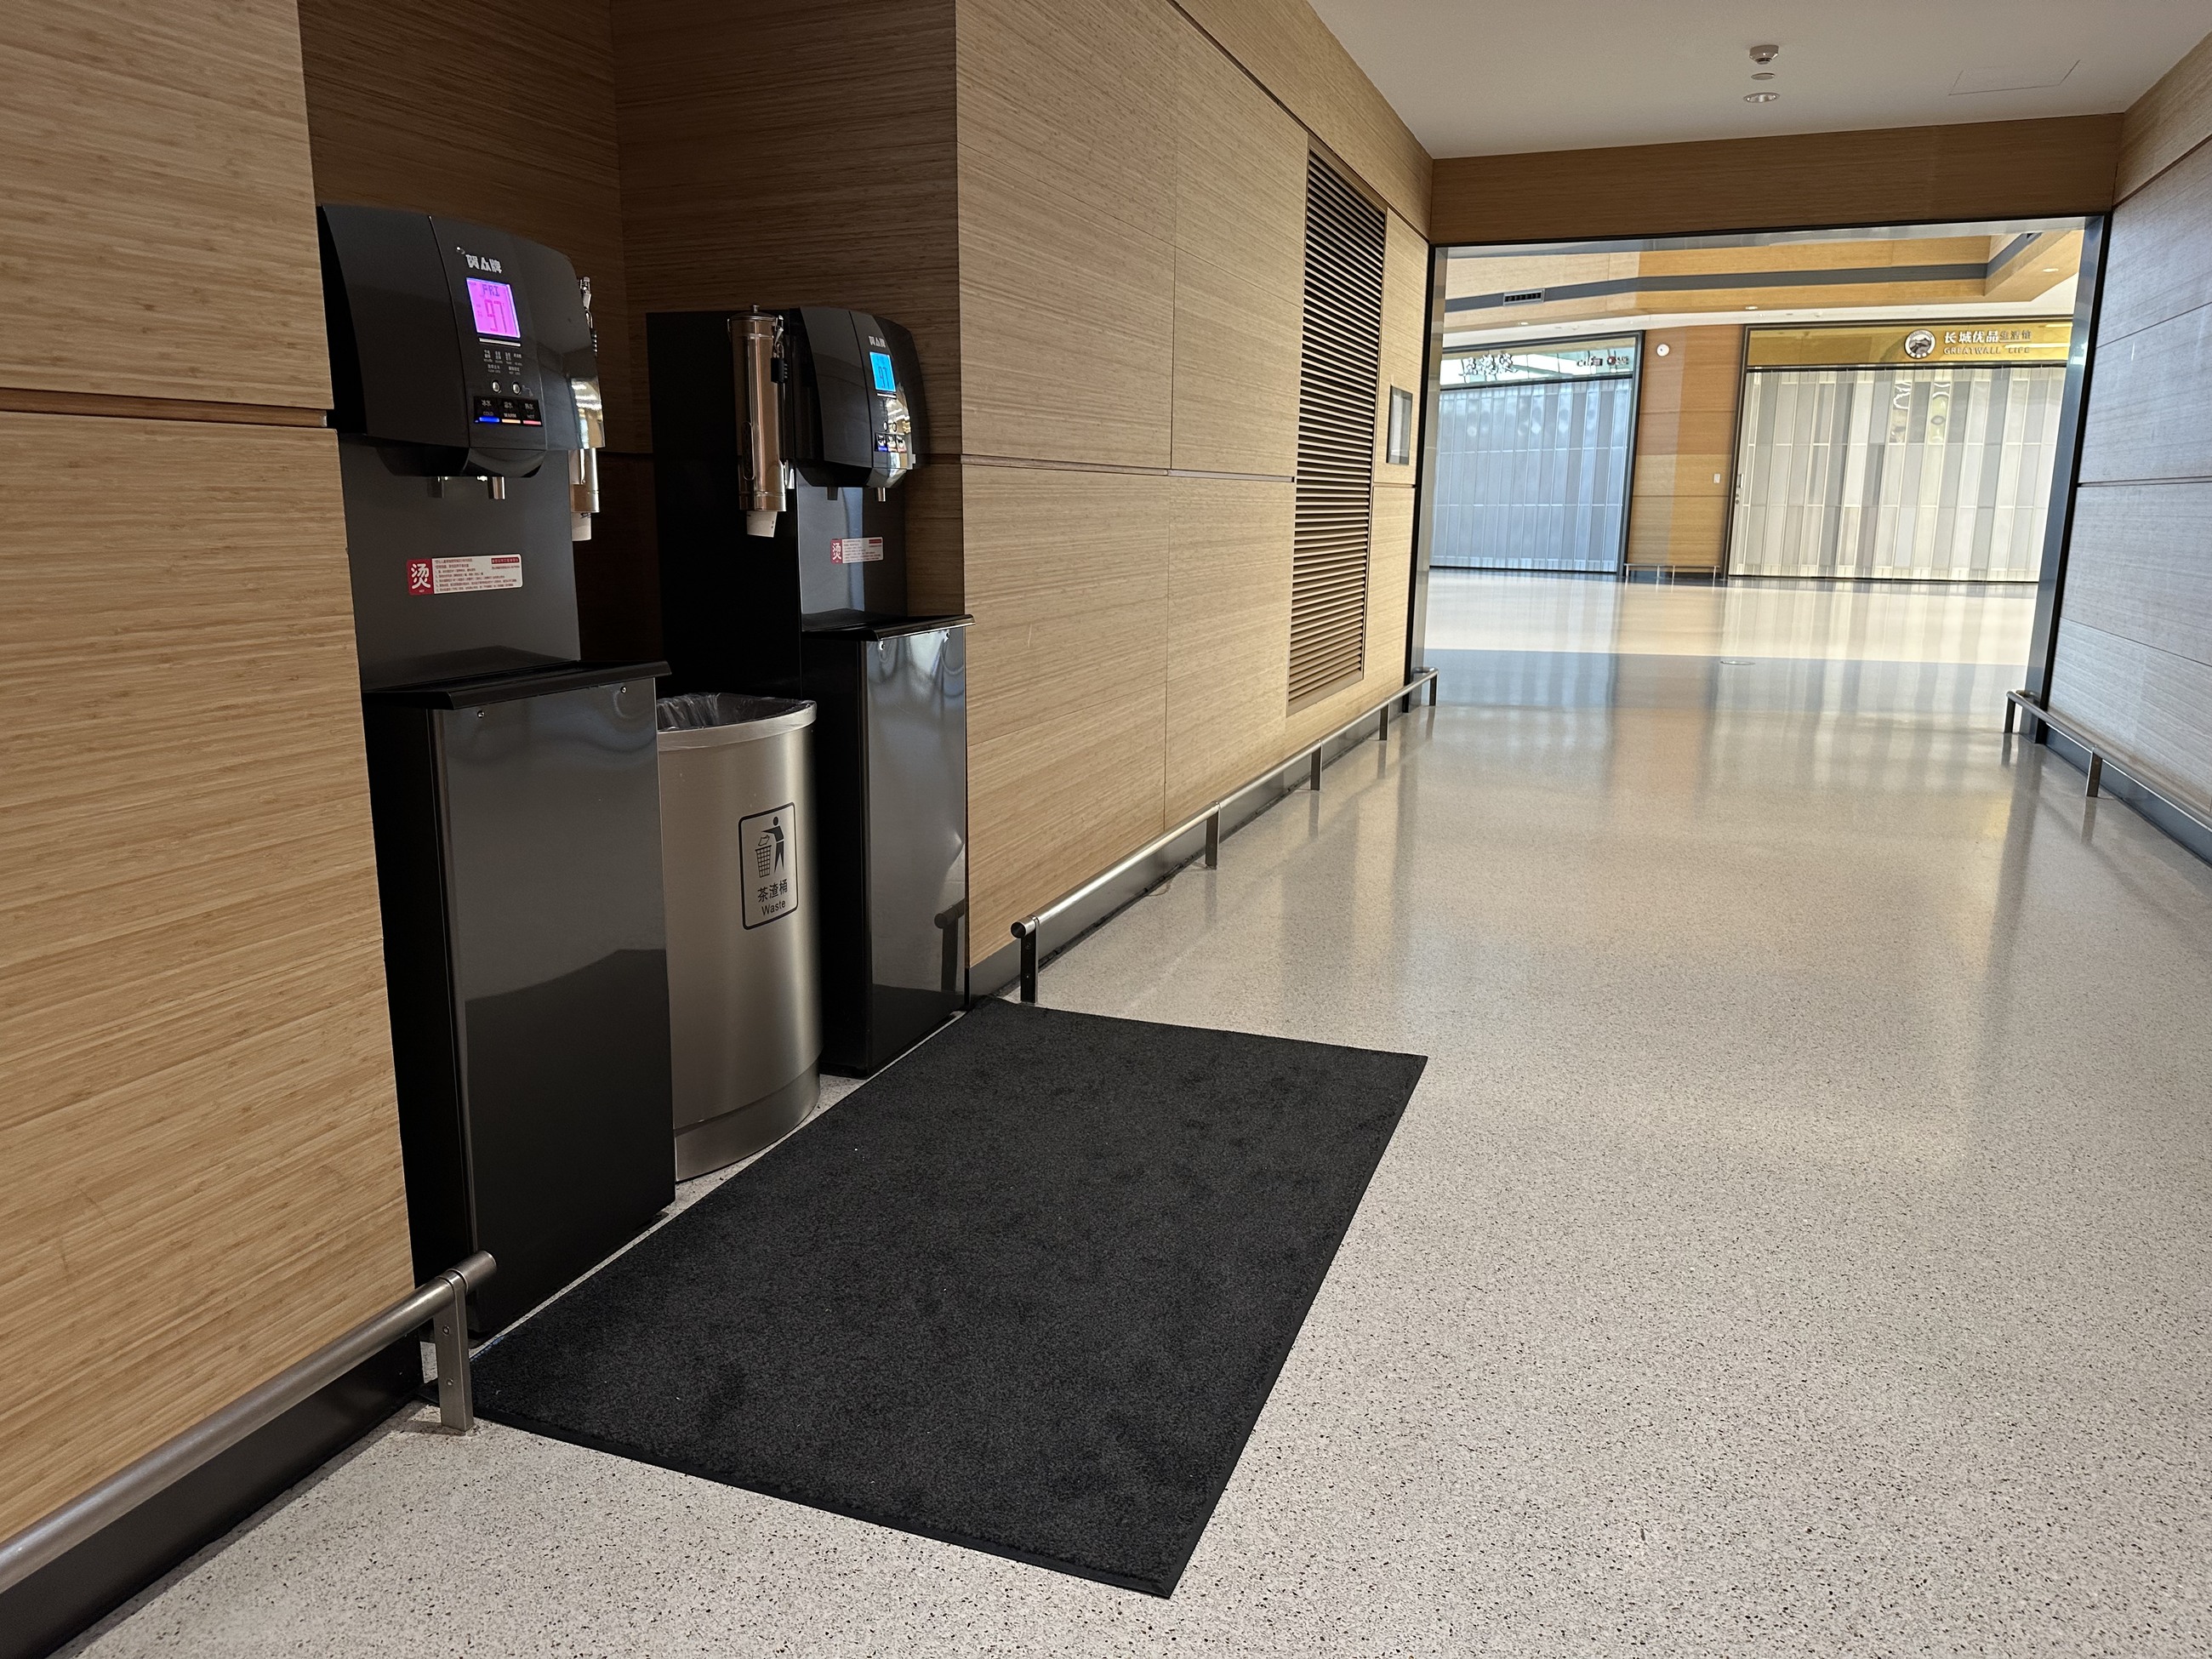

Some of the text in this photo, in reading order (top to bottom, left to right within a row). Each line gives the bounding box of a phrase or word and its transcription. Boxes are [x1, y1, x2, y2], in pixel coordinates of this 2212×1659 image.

[482, 283, 500, 297] FRI
[484, 299, 507, 334] 97
[1943, 346, 2001, 355] GREATWALL
[411, 563, 431, 590] 烫
[757, 878, 788, 903] 茶渣桶
[761, 900, 786, 916] Waste
